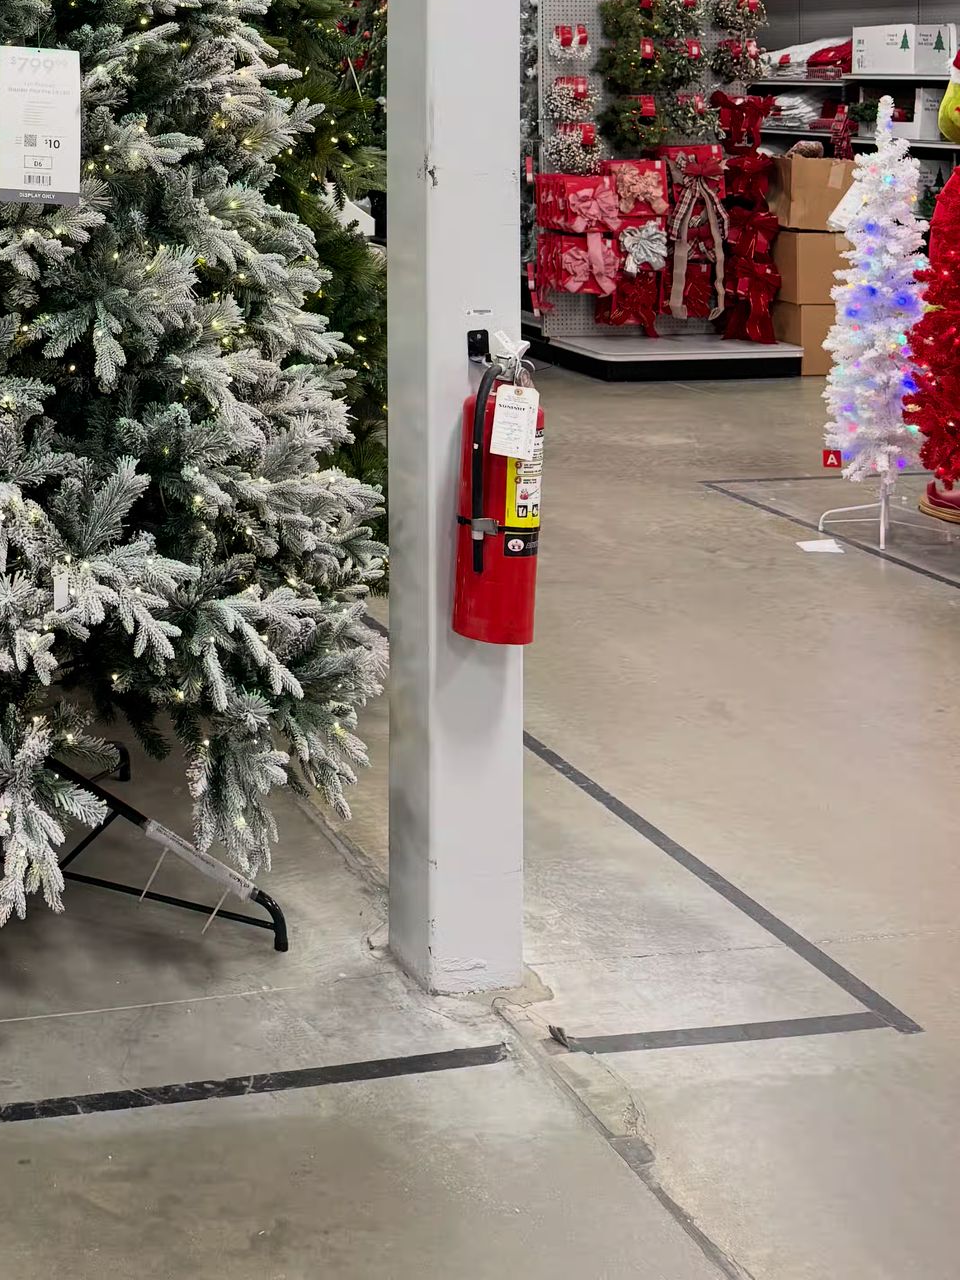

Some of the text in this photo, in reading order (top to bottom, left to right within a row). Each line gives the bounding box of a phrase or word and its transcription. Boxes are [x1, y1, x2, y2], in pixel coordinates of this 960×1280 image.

[44, 138, 61, 149] $10
[41, 193, 56, 201] ONLY
[826, 453, 838, 465] A
